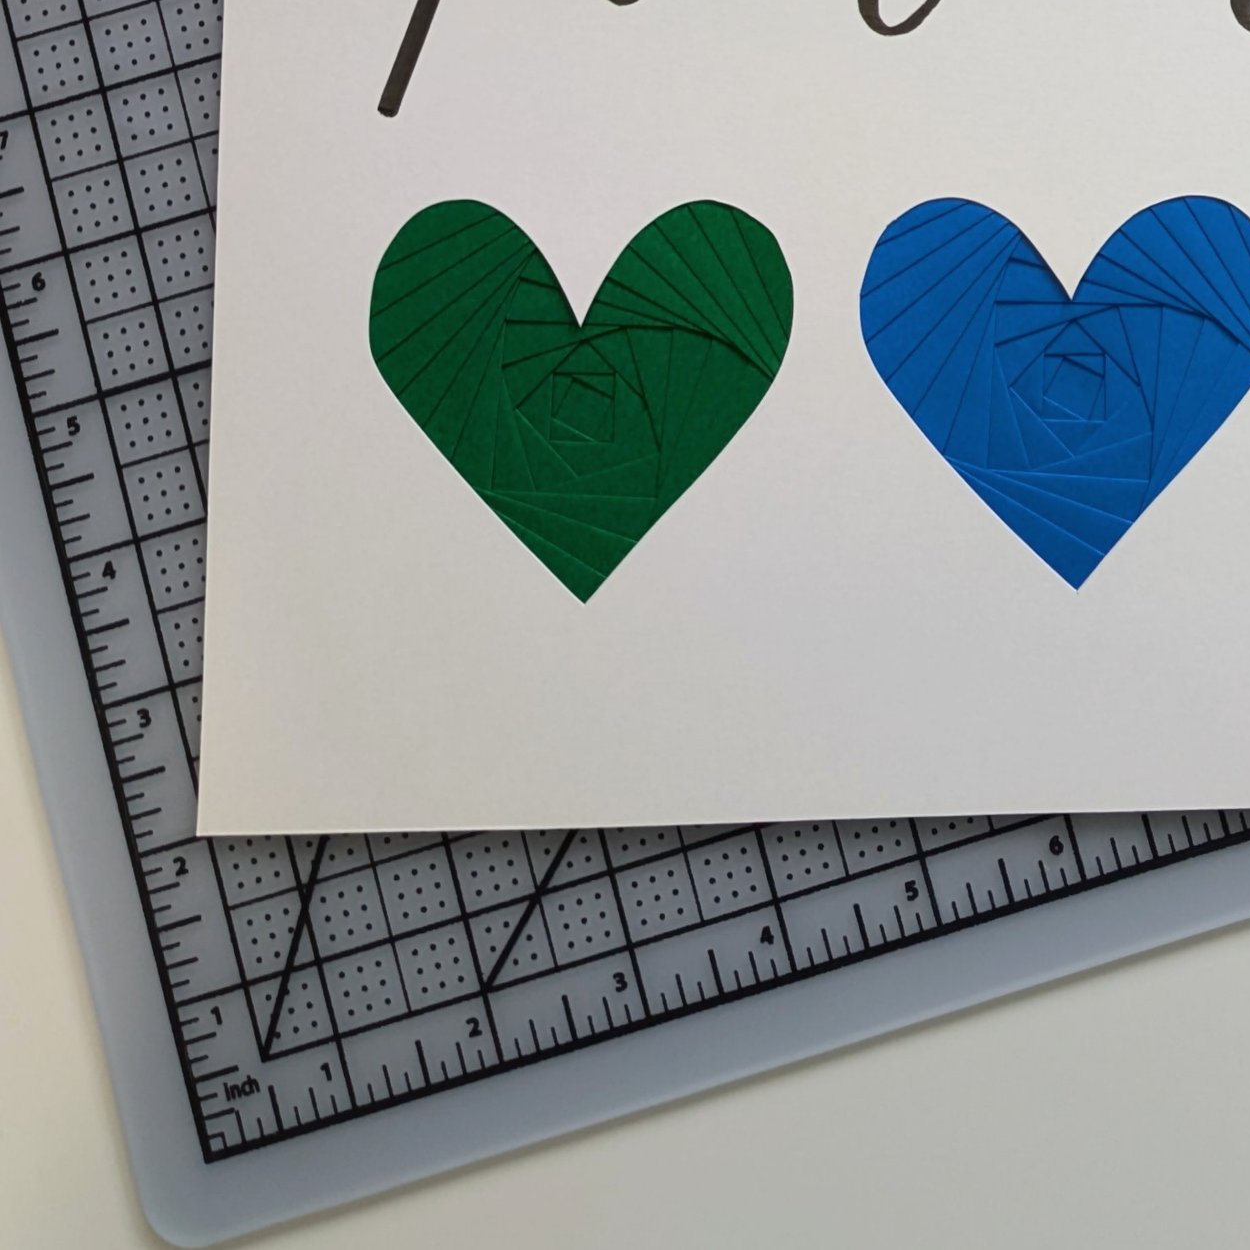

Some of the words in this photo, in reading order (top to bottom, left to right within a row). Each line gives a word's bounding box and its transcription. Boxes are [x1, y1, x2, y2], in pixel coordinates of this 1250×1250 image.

[32, 272, 46, 291] 6
[66, 416, 80, 436] 5
[102, 560, 116, 579] 4
[137, 709, 151, 729] 3
[1049, 835, 1064, 855] 6
[173, 857, 188, 877] 2
[905, 880, 918, 901] 5
[760, 926, 774, 946] 4
[613, 973, 627, 993] 3
[211, 1006, 222, 1025] 1
[466, 1018, 482, 1038] 2
[320, 1062, 332, 1081] 1
